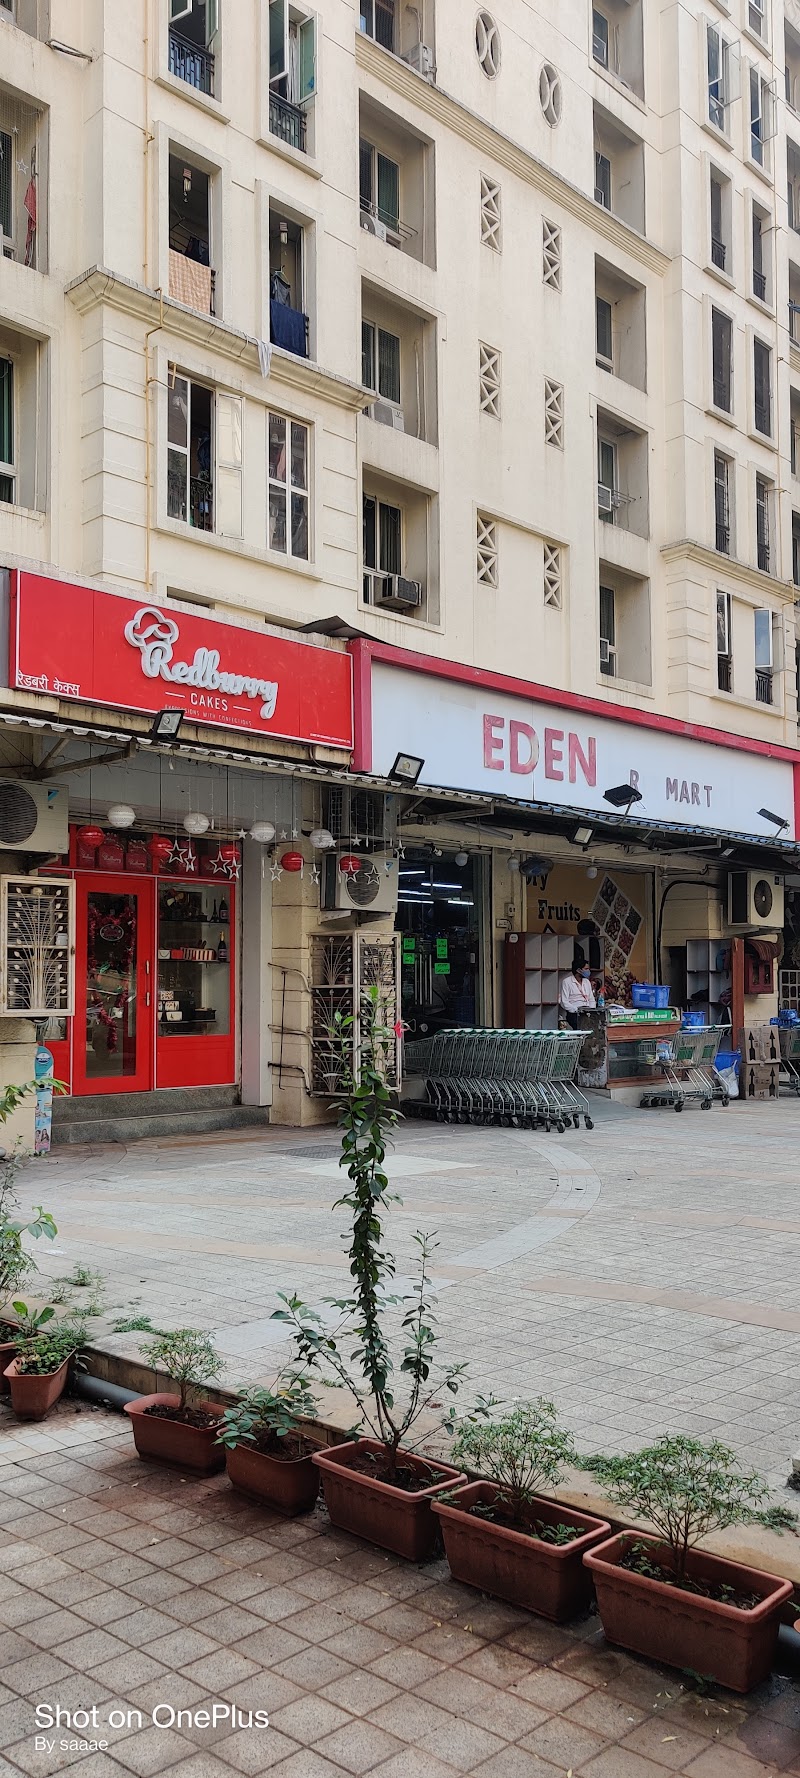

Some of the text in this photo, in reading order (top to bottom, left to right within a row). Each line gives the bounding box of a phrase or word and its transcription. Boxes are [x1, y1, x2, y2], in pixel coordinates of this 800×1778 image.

[18, 670, 80, 697] रेडबरी केक्स
[141, 641, 279, 719] Redburry
[190, 692, 228, 711] CAKES
[483, 713, 597, 787] EDEN
[666, 776, 713, 807] MART
[538, 899, 581, 921] Fruits
